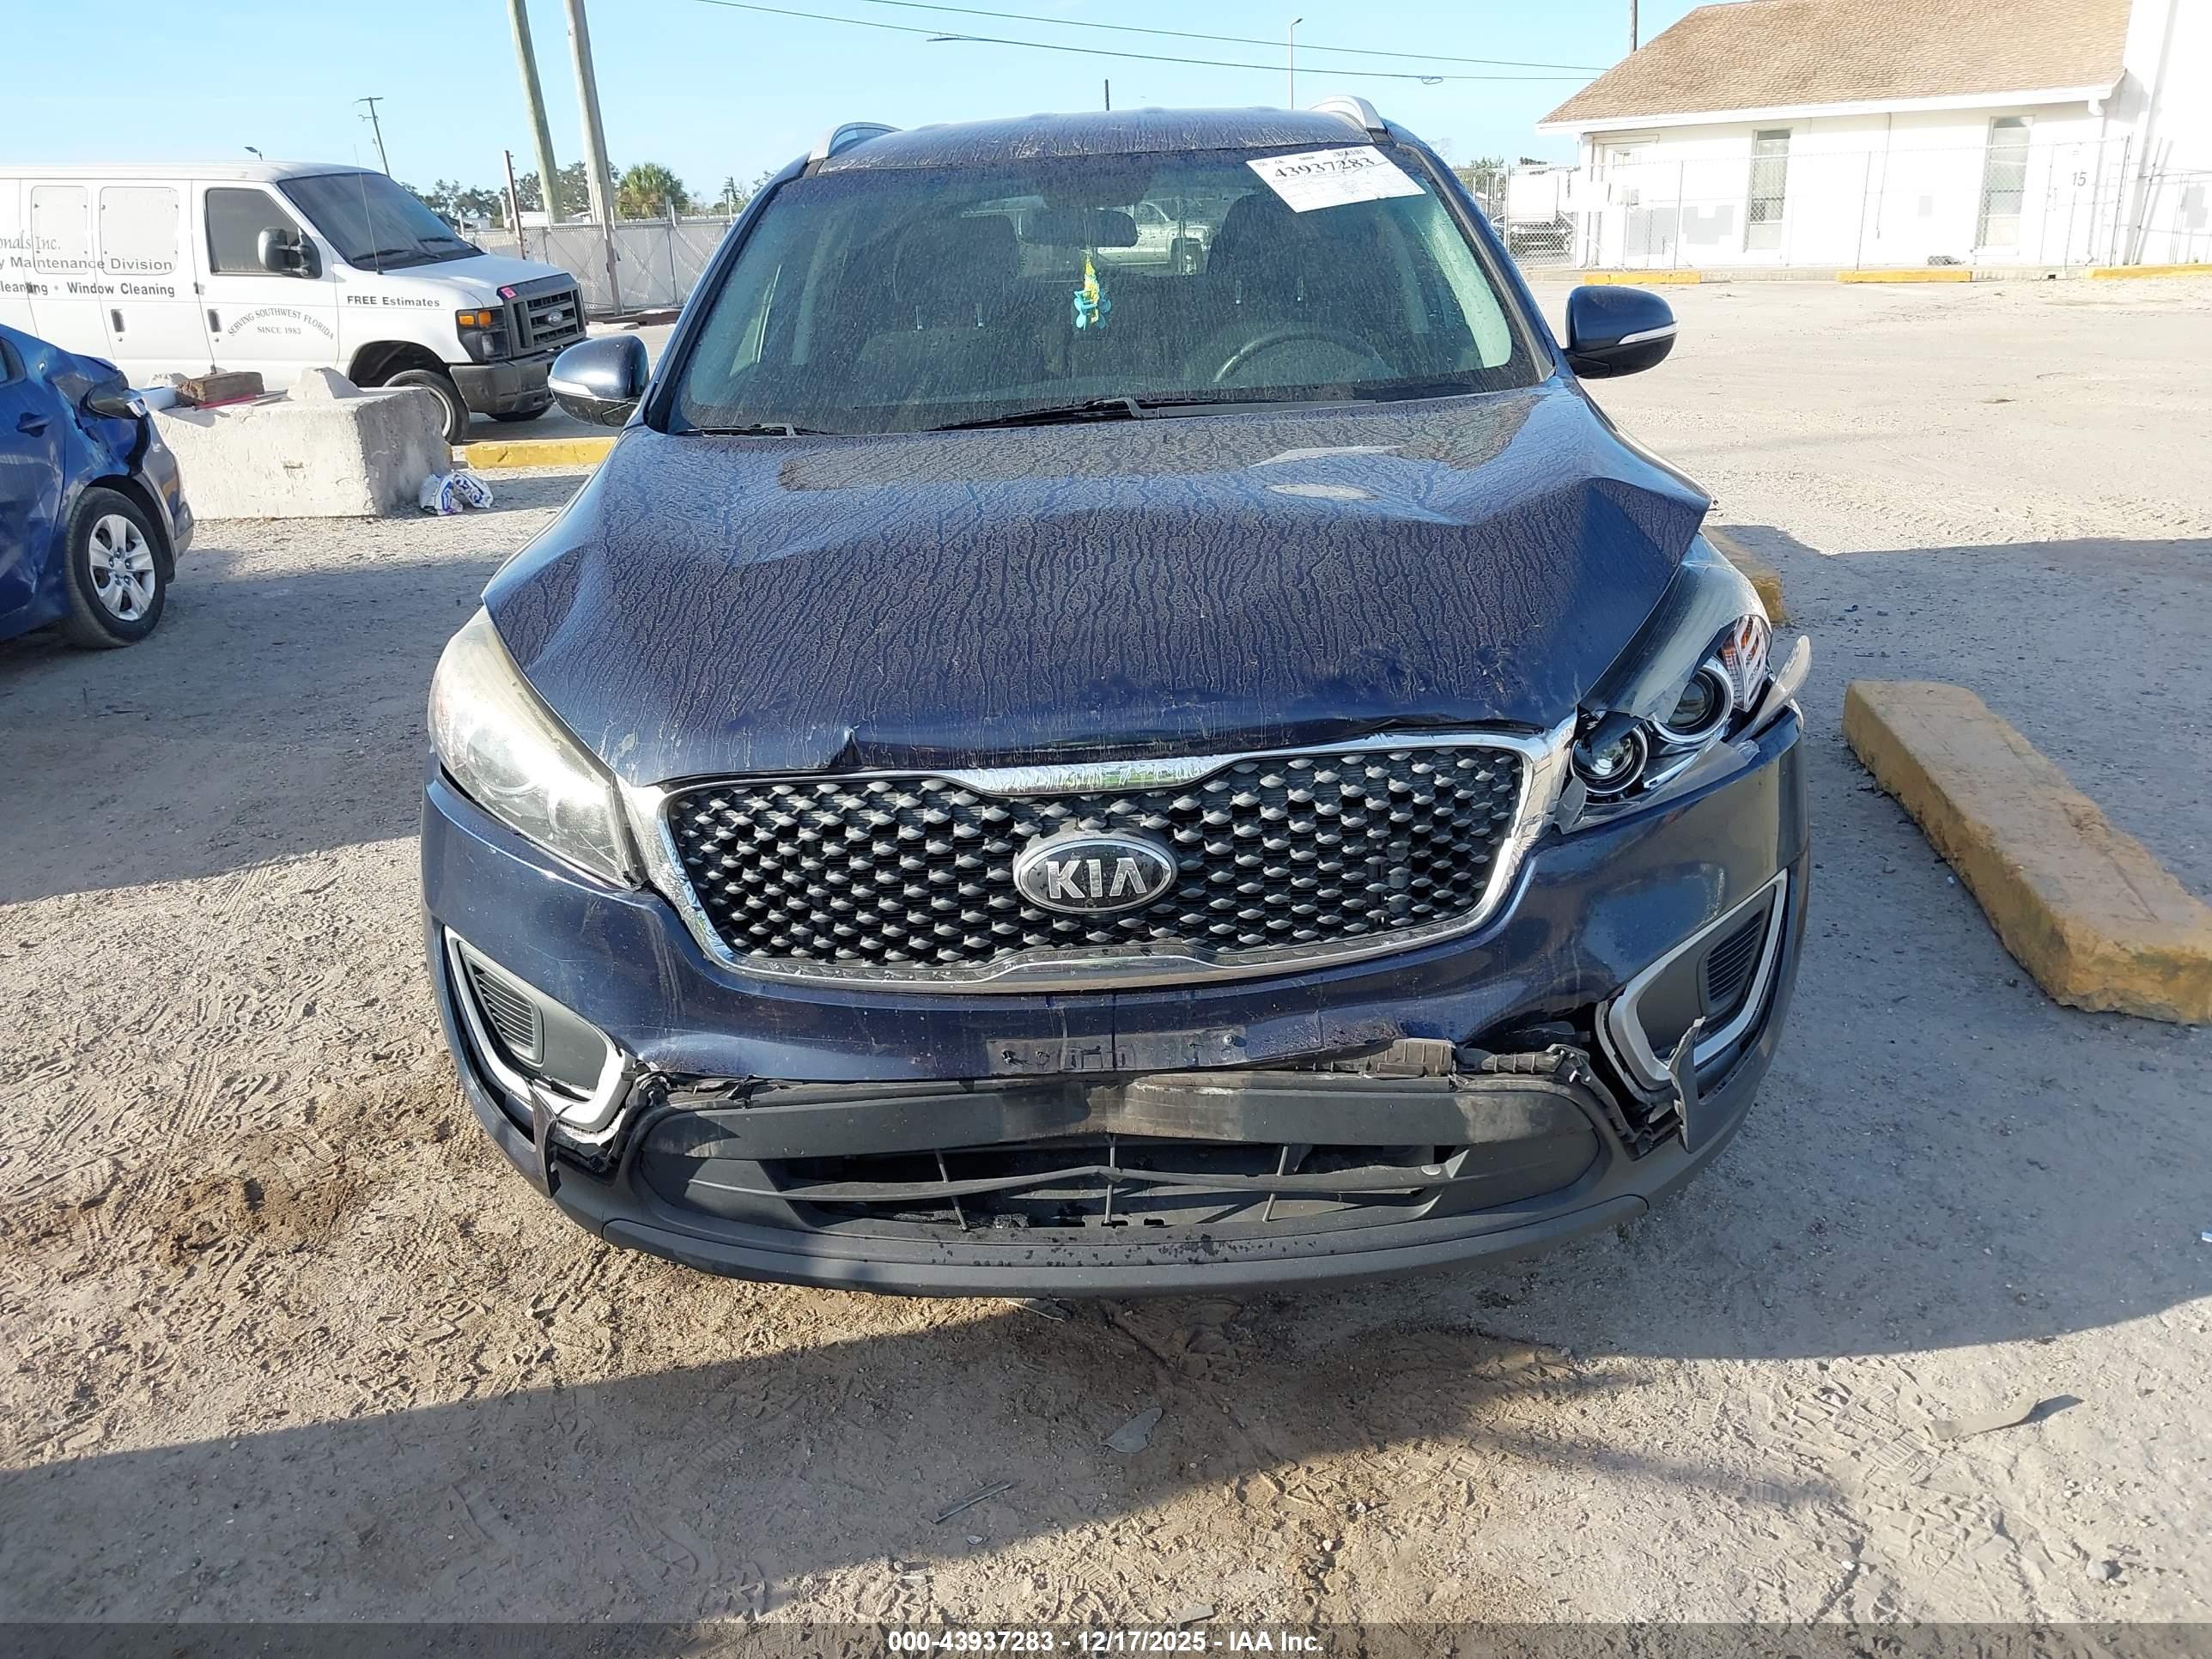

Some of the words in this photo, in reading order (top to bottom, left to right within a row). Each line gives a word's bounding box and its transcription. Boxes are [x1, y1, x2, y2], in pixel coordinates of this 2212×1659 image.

[1275, 157, 1375, 178] 43937283
[2072, 172, 2087, 186] 15
[35, 236, 61, 250] Inc.
[10, 256, 105, 270] Maintenance
[111, 258, 173, 270] Division
[66, 282, 114, 295] Window
[120, 283, 175, 298] Cleaning
[347, 295, 378, 305] FREE
[382, 296, 441, 307] Estimates
[228, 313, 255, 337] SERVING
[255, 307, 302, 319] SOUTHWEST
[303, 314, 334, 340] FLORIDA
[1046, 857, 1148, 899] KIA
